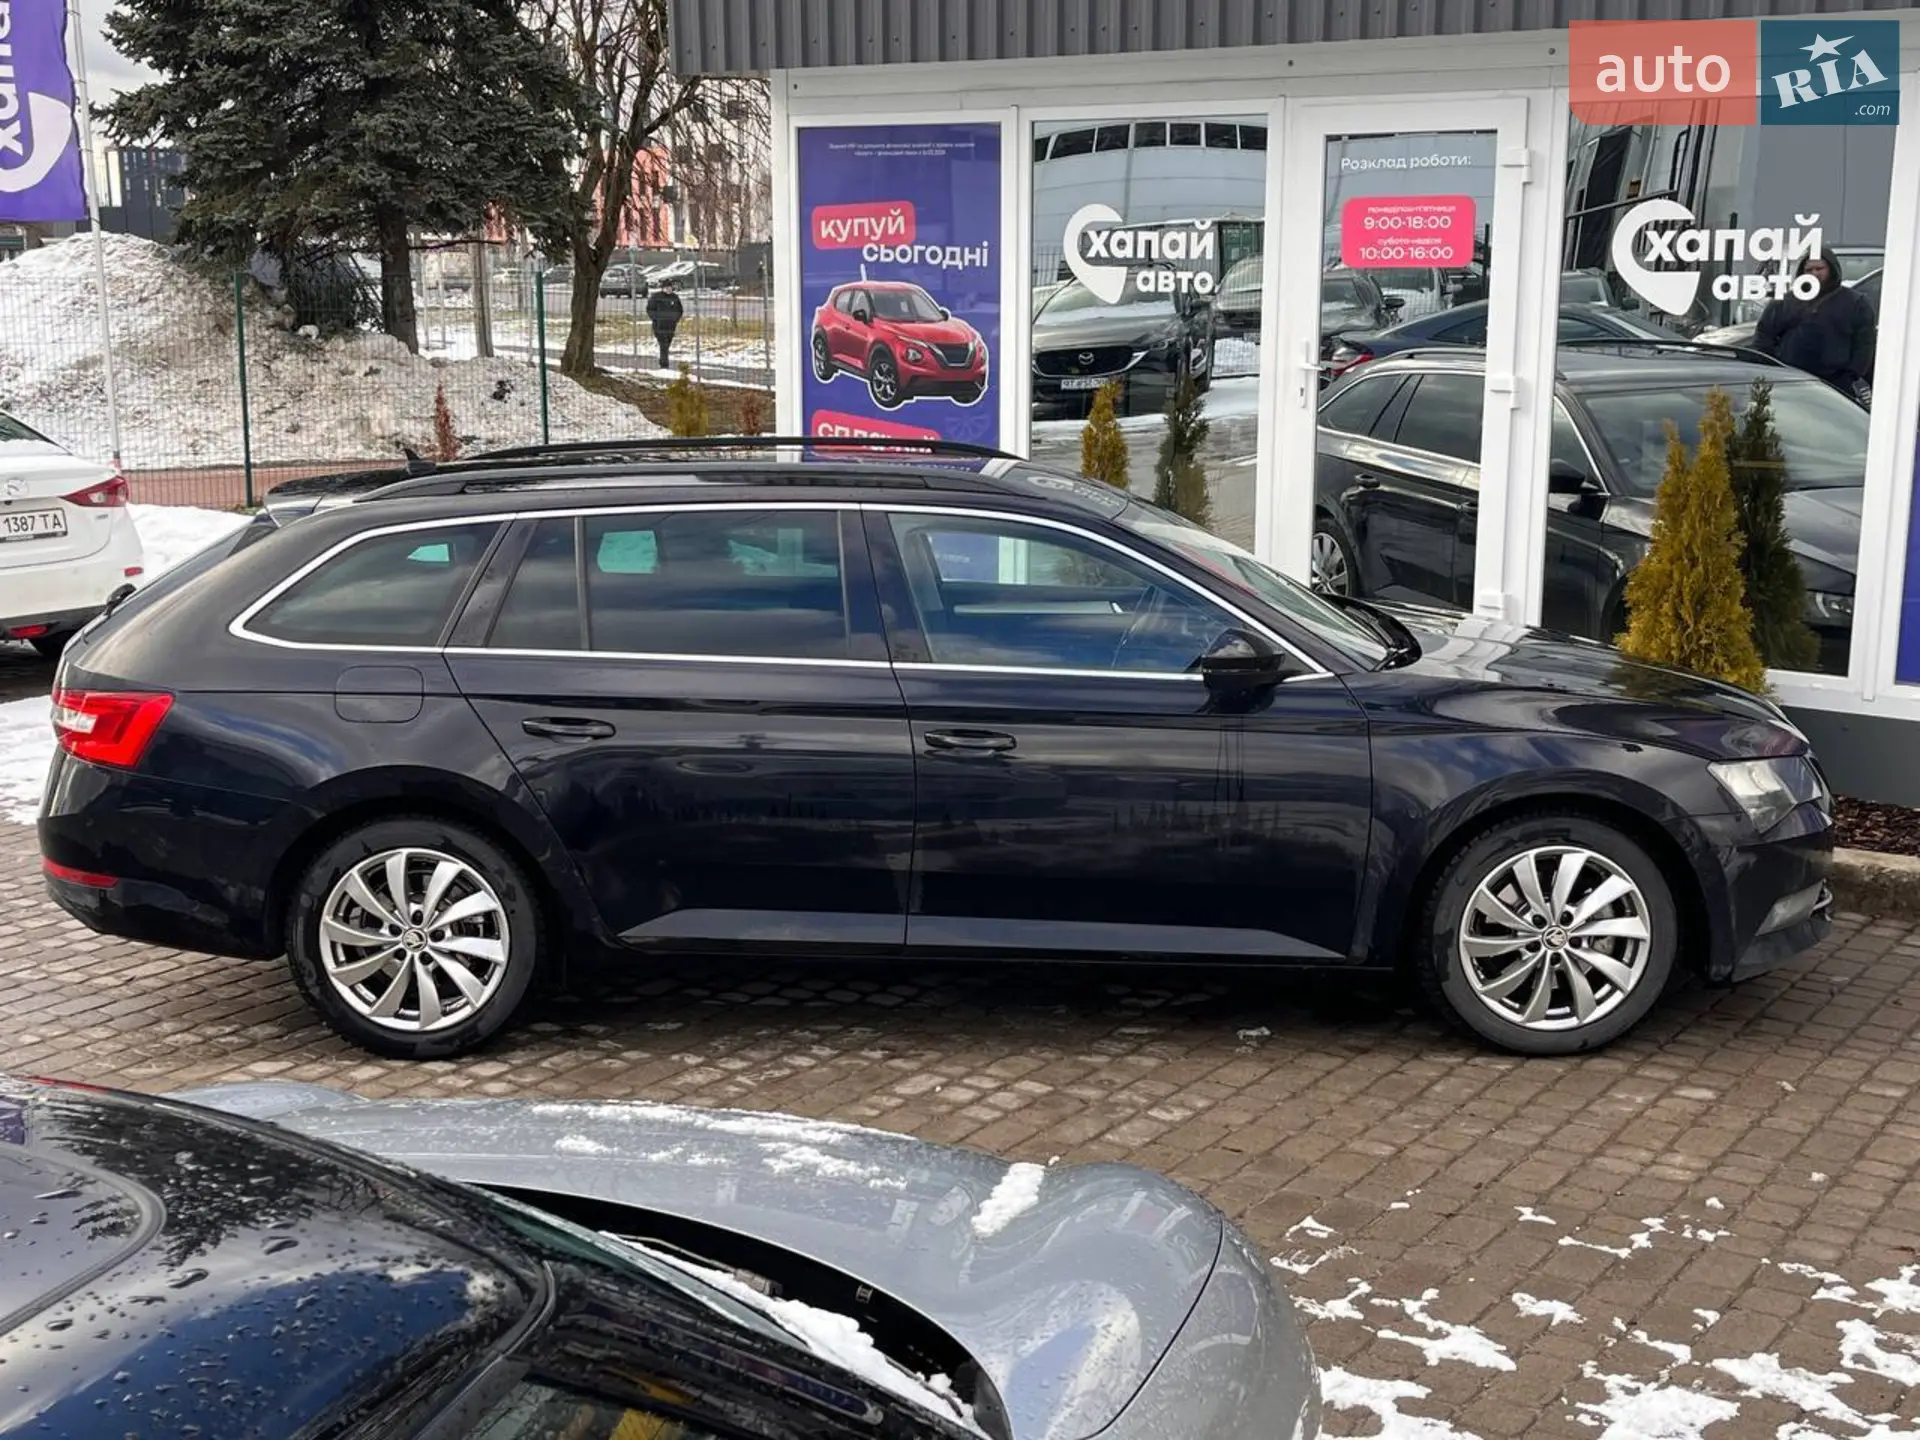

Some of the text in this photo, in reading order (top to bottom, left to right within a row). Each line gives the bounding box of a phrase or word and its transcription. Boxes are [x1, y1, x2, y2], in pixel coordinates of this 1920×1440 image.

[1341, 153, 1472, 171] Розклад роботи:
[820, 208, 905, 243] купуй
[1363, 215, 1452, 230] 9:00-18:00
[1086, 219, 1215, 260] хапай
[1643, 213, 1823, 262] хапай
[862, 240, 989, 270] сьогодні
[1359, 246, 1454, 260] 10:00-16:00
[1136, 270, 1214, 294] авто
[1711, 273, 1821, 301] авто
[3, 513, 63, 533] 1387 TA
